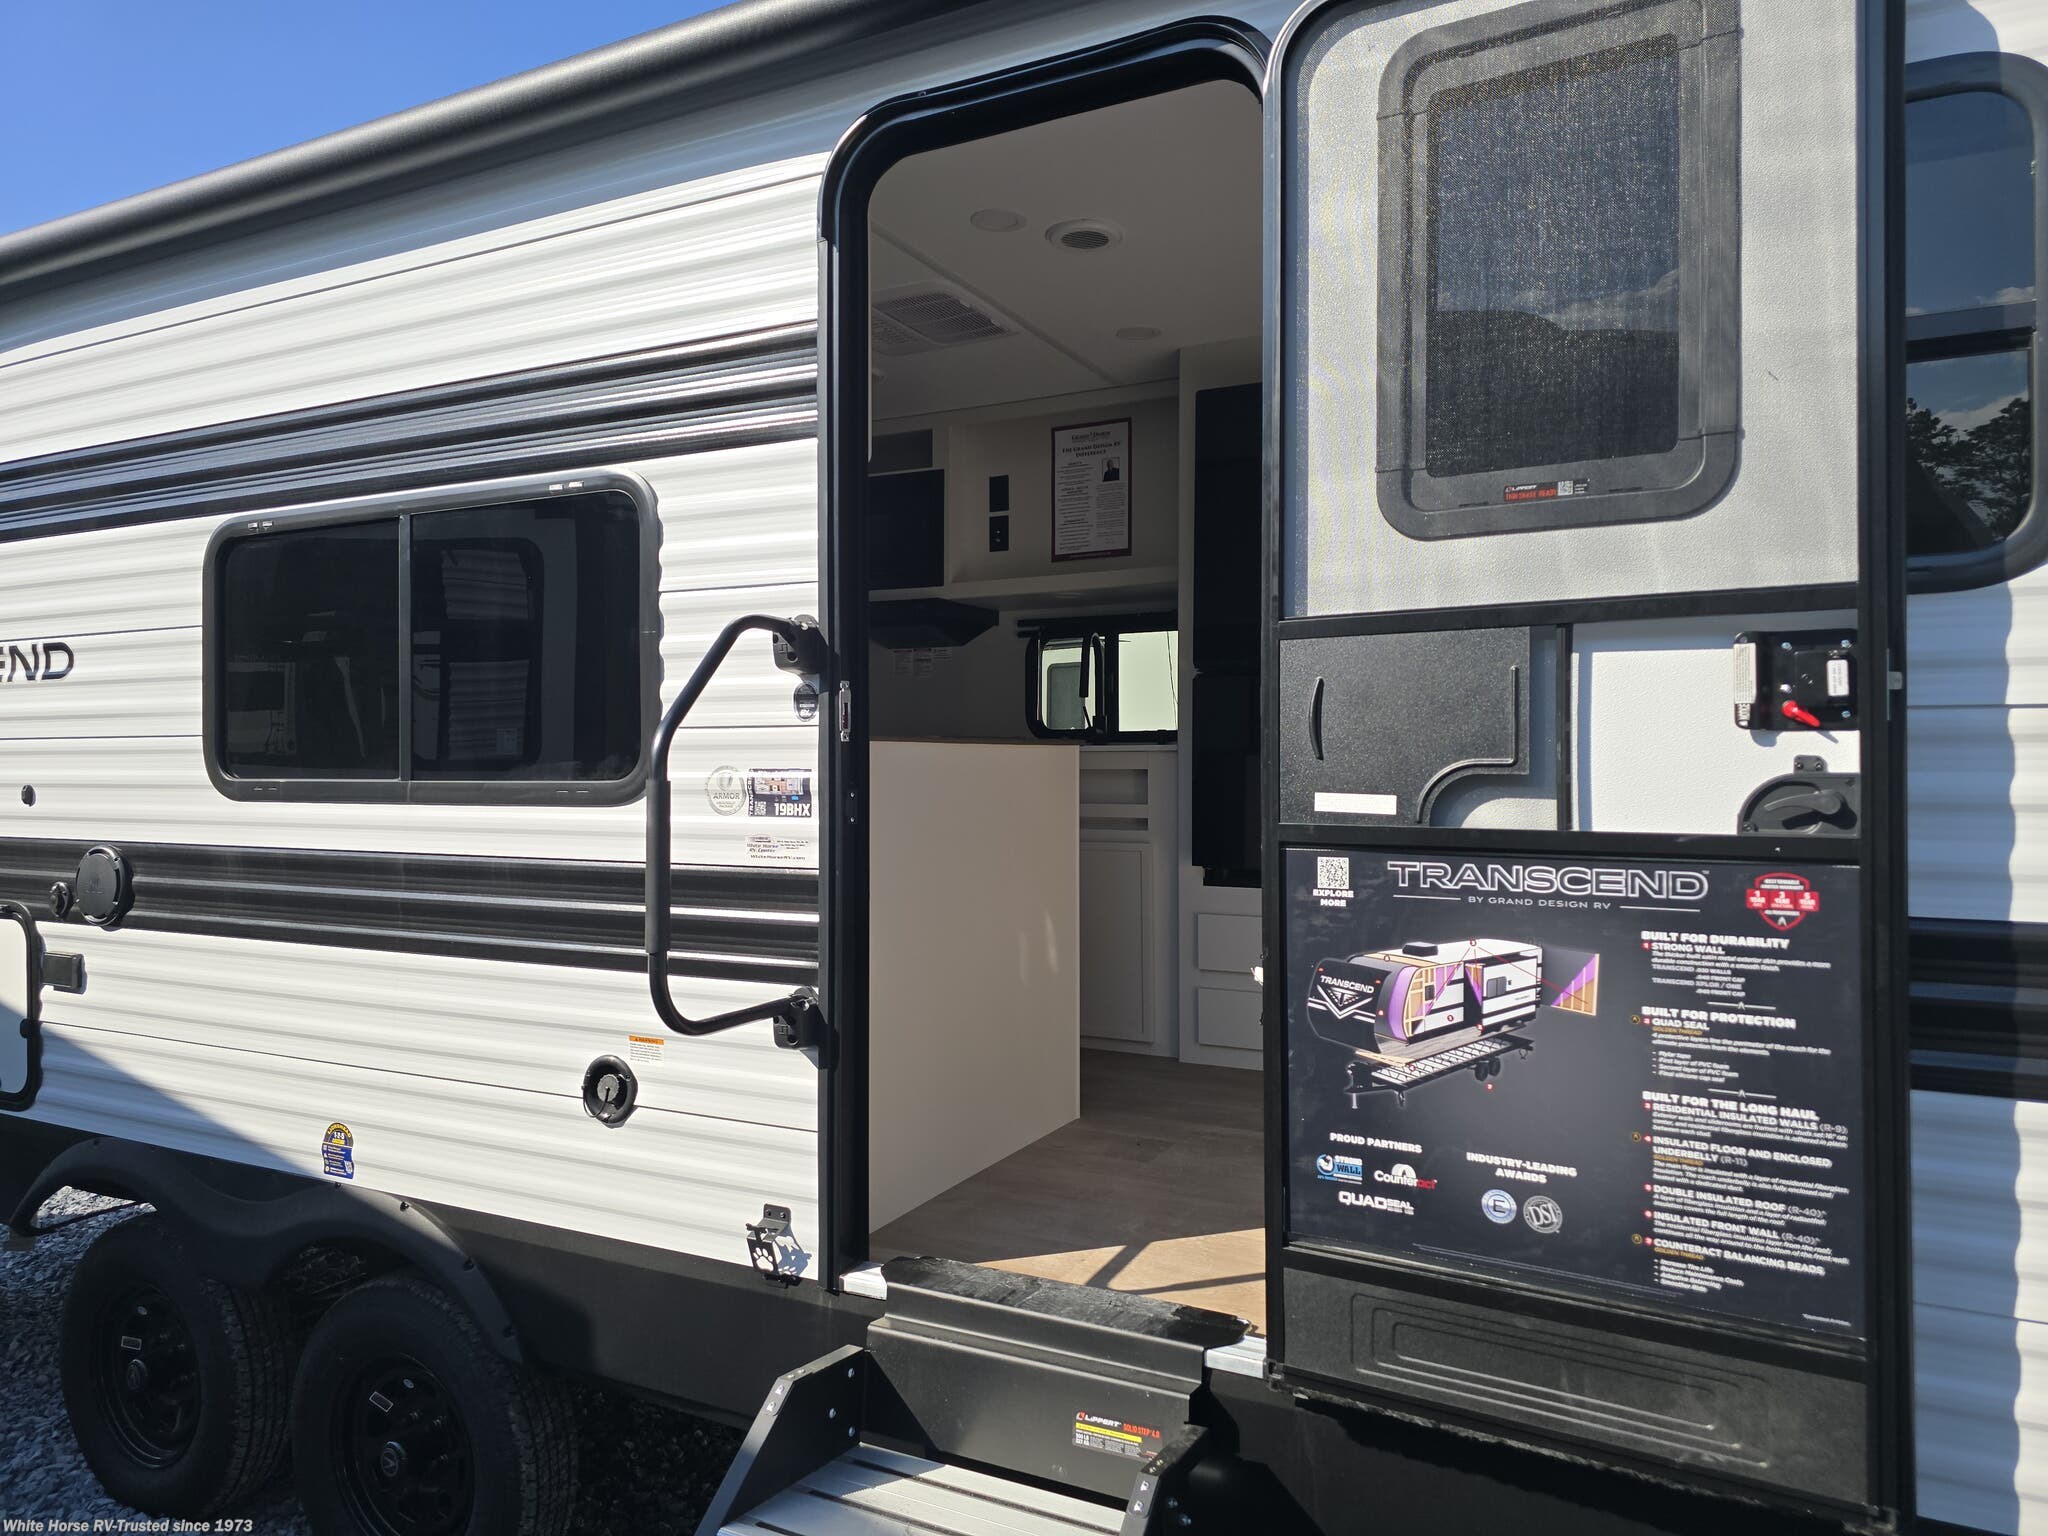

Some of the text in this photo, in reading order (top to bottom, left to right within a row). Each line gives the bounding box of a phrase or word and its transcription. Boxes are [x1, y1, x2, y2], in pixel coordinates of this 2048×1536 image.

[713, 792, 740, 800] ARMOR
[774, 802, 811, 817] 19BHX
[1387, 860, 1708, 900] TRANSCEND
[1312, 888, 1354, 899] EXPLORE
[1320, 898, 1347, 907] MORE
[1468, 896, 1612, 910] BY GRAND DESIGN RV
[1642, 930, 1789, 949] BUILT FOR DURABILITY
[1652, 942, 1693, 952] STRONG
[1694, 945, 1724, 954] WALL
[1320, 975, 1374, 994] TRANSCEND
[1642, 1006, 1796, 1029] BUILT FOR PROTECTION
[1652, 1018, 1682, 1029] QUAD
[1683, 1021, 1710, 1030] SEAL
[1642, 1091, 1818, 1120] BUILT FOR THE LONG HAUL
[1652, 1103, 1718, 1118] RESIDENTIAL
[1719, 1111, 1777, 1126] INSULATED
[1779, 1118, 1817, 1130] WALLS
[1330, 1132, 1422, 1153] PROUD PARTNERS
[1652, 1136, 1709, 1151] INSULATED
[1710, 1144, 1746, 1156] FLOOR
[1747, 1148, 1772, 1159] AND
[1773, 1152, 1831, 1167] ENCLOSED
[1653, 1146, 1718, 1162] UNDERBELLY
[1336, 1163, 1361, 1175] WALL
[1466, 1151, 1577, 1177] INDUSTRY-LEADING
[1374, 1169, 1435, 1189] Counteract
[1495, 1167, 1547, 1183] AWARDS
[1652, 1185, 1694, 1199] DOUBLE
[1696, 1191, 1753, 1207] INSULATED
[1754, 1200, 1785, 1212] ROOF
[1528, 1203, 1558, 1225] DSI
[1654, 1212, 1710, 1228] INSULATED
[1711, 1221, 1747, 1234] FRONT
[1748, 1226, 1779, 1238] WALL
[1654, 1239, 1722, 1258] COUNTERACT
[1723, 1250, 1785, 1268] BALANCING
[1786, 1260, 1824, 1275] BEADS
[1084, 1414, 1121, 1427] LIPPERT
